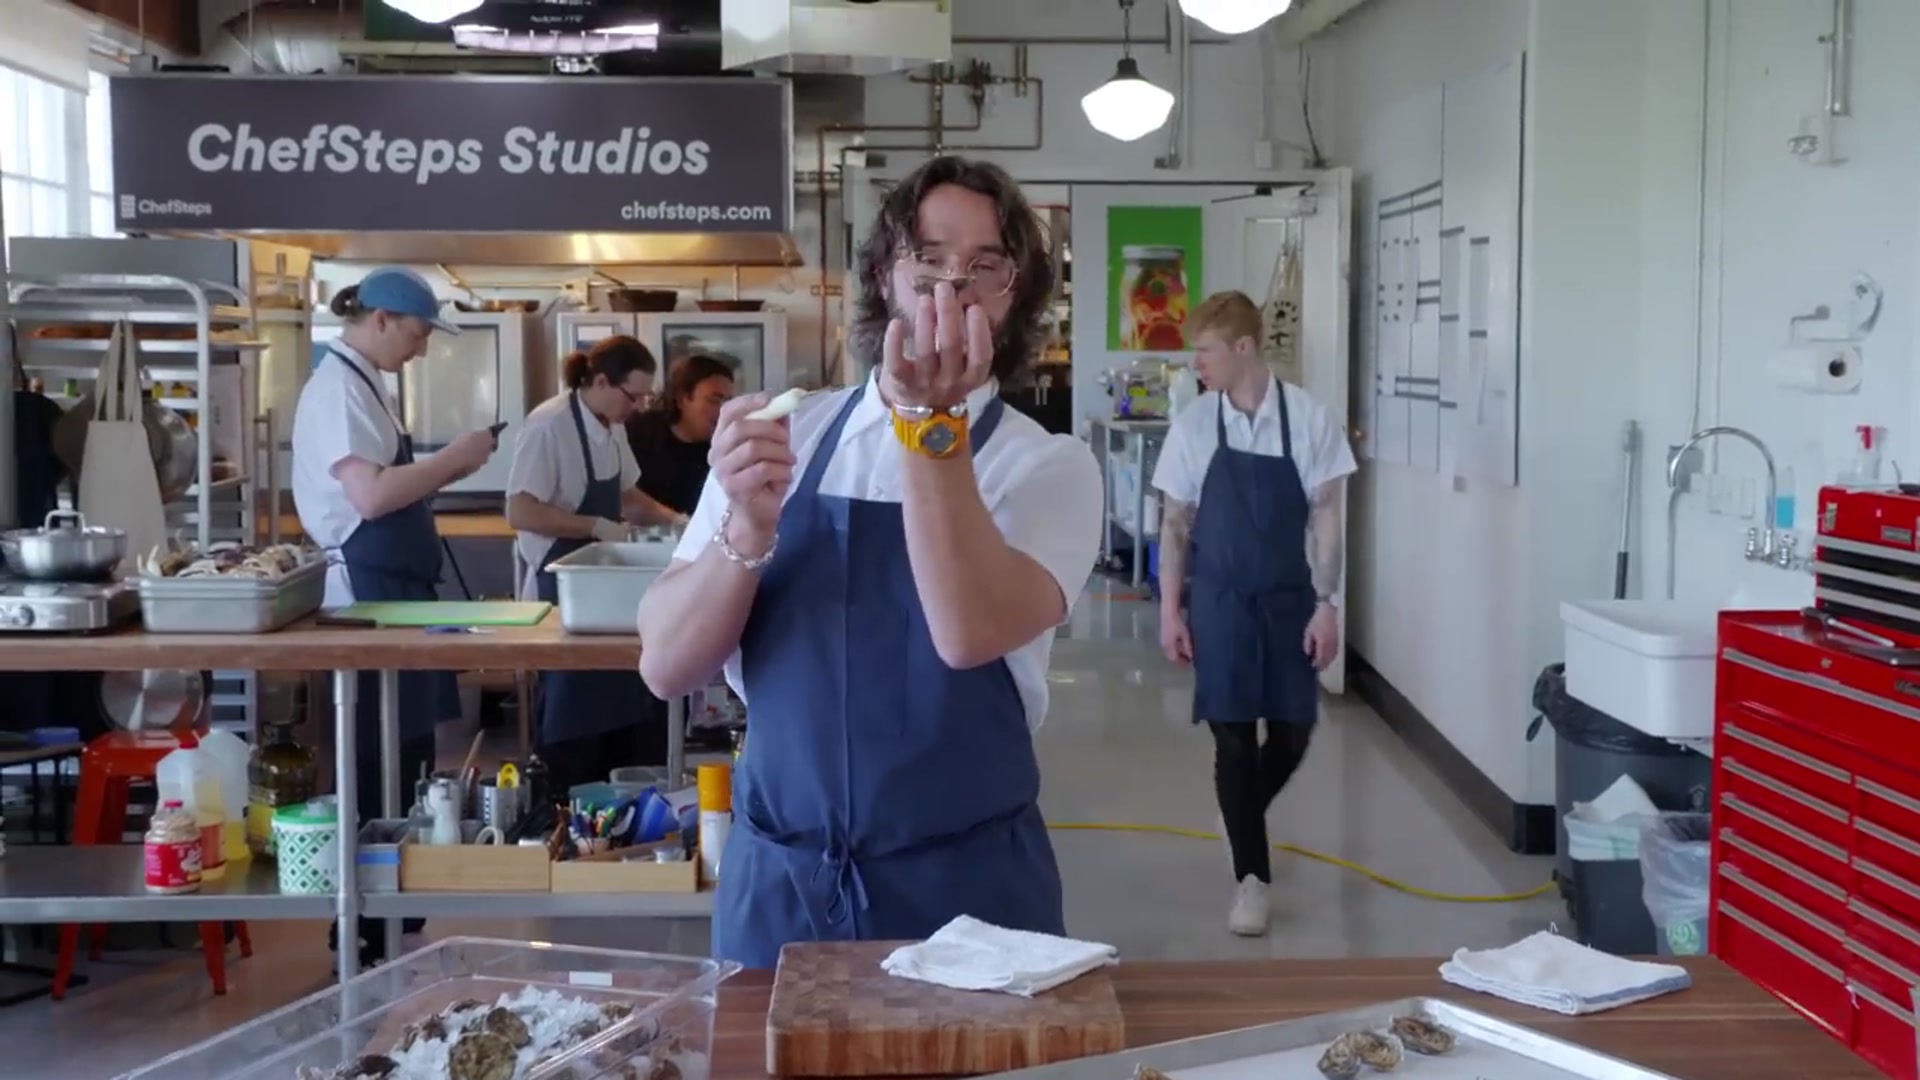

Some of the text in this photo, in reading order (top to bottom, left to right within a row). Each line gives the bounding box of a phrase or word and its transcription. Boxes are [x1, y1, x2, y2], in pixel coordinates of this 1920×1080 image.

[187, 123, 711, 185] ChefSteps Studios
[138, 199, 213, 217] ChefSteps
[620, 201, 772, 223] chefsteps.com
